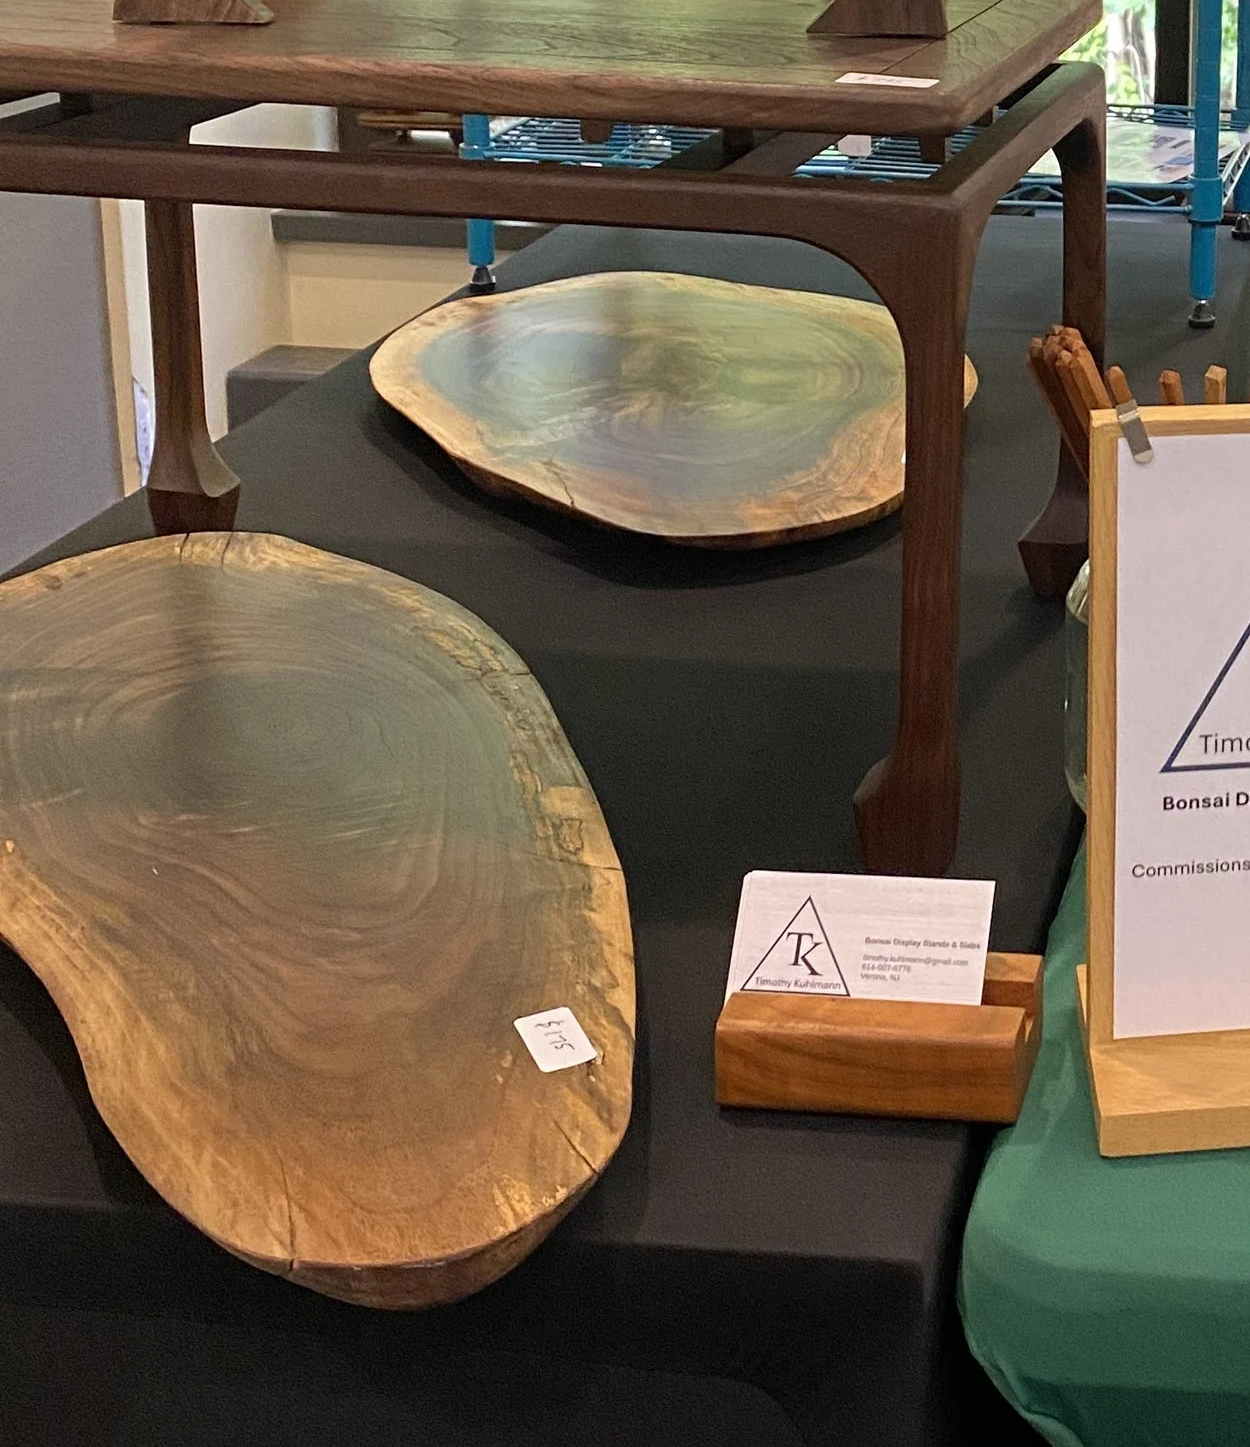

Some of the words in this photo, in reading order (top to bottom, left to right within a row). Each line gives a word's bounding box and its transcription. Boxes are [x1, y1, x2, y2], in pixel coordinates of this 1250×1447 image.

[1162, 792, 1230, 811] Bonsai
[1132, 859, 1250, 878] Commissions
[893, 938, 921, 948] Display
[923, 940, 949, 948] Stands
[959, 941, 981, 949] Slabs
[786, 932, 823, 976] TK
[755, 976, 792, 988] Timothy
[794, 979, 841, 990] Kuhlmann
